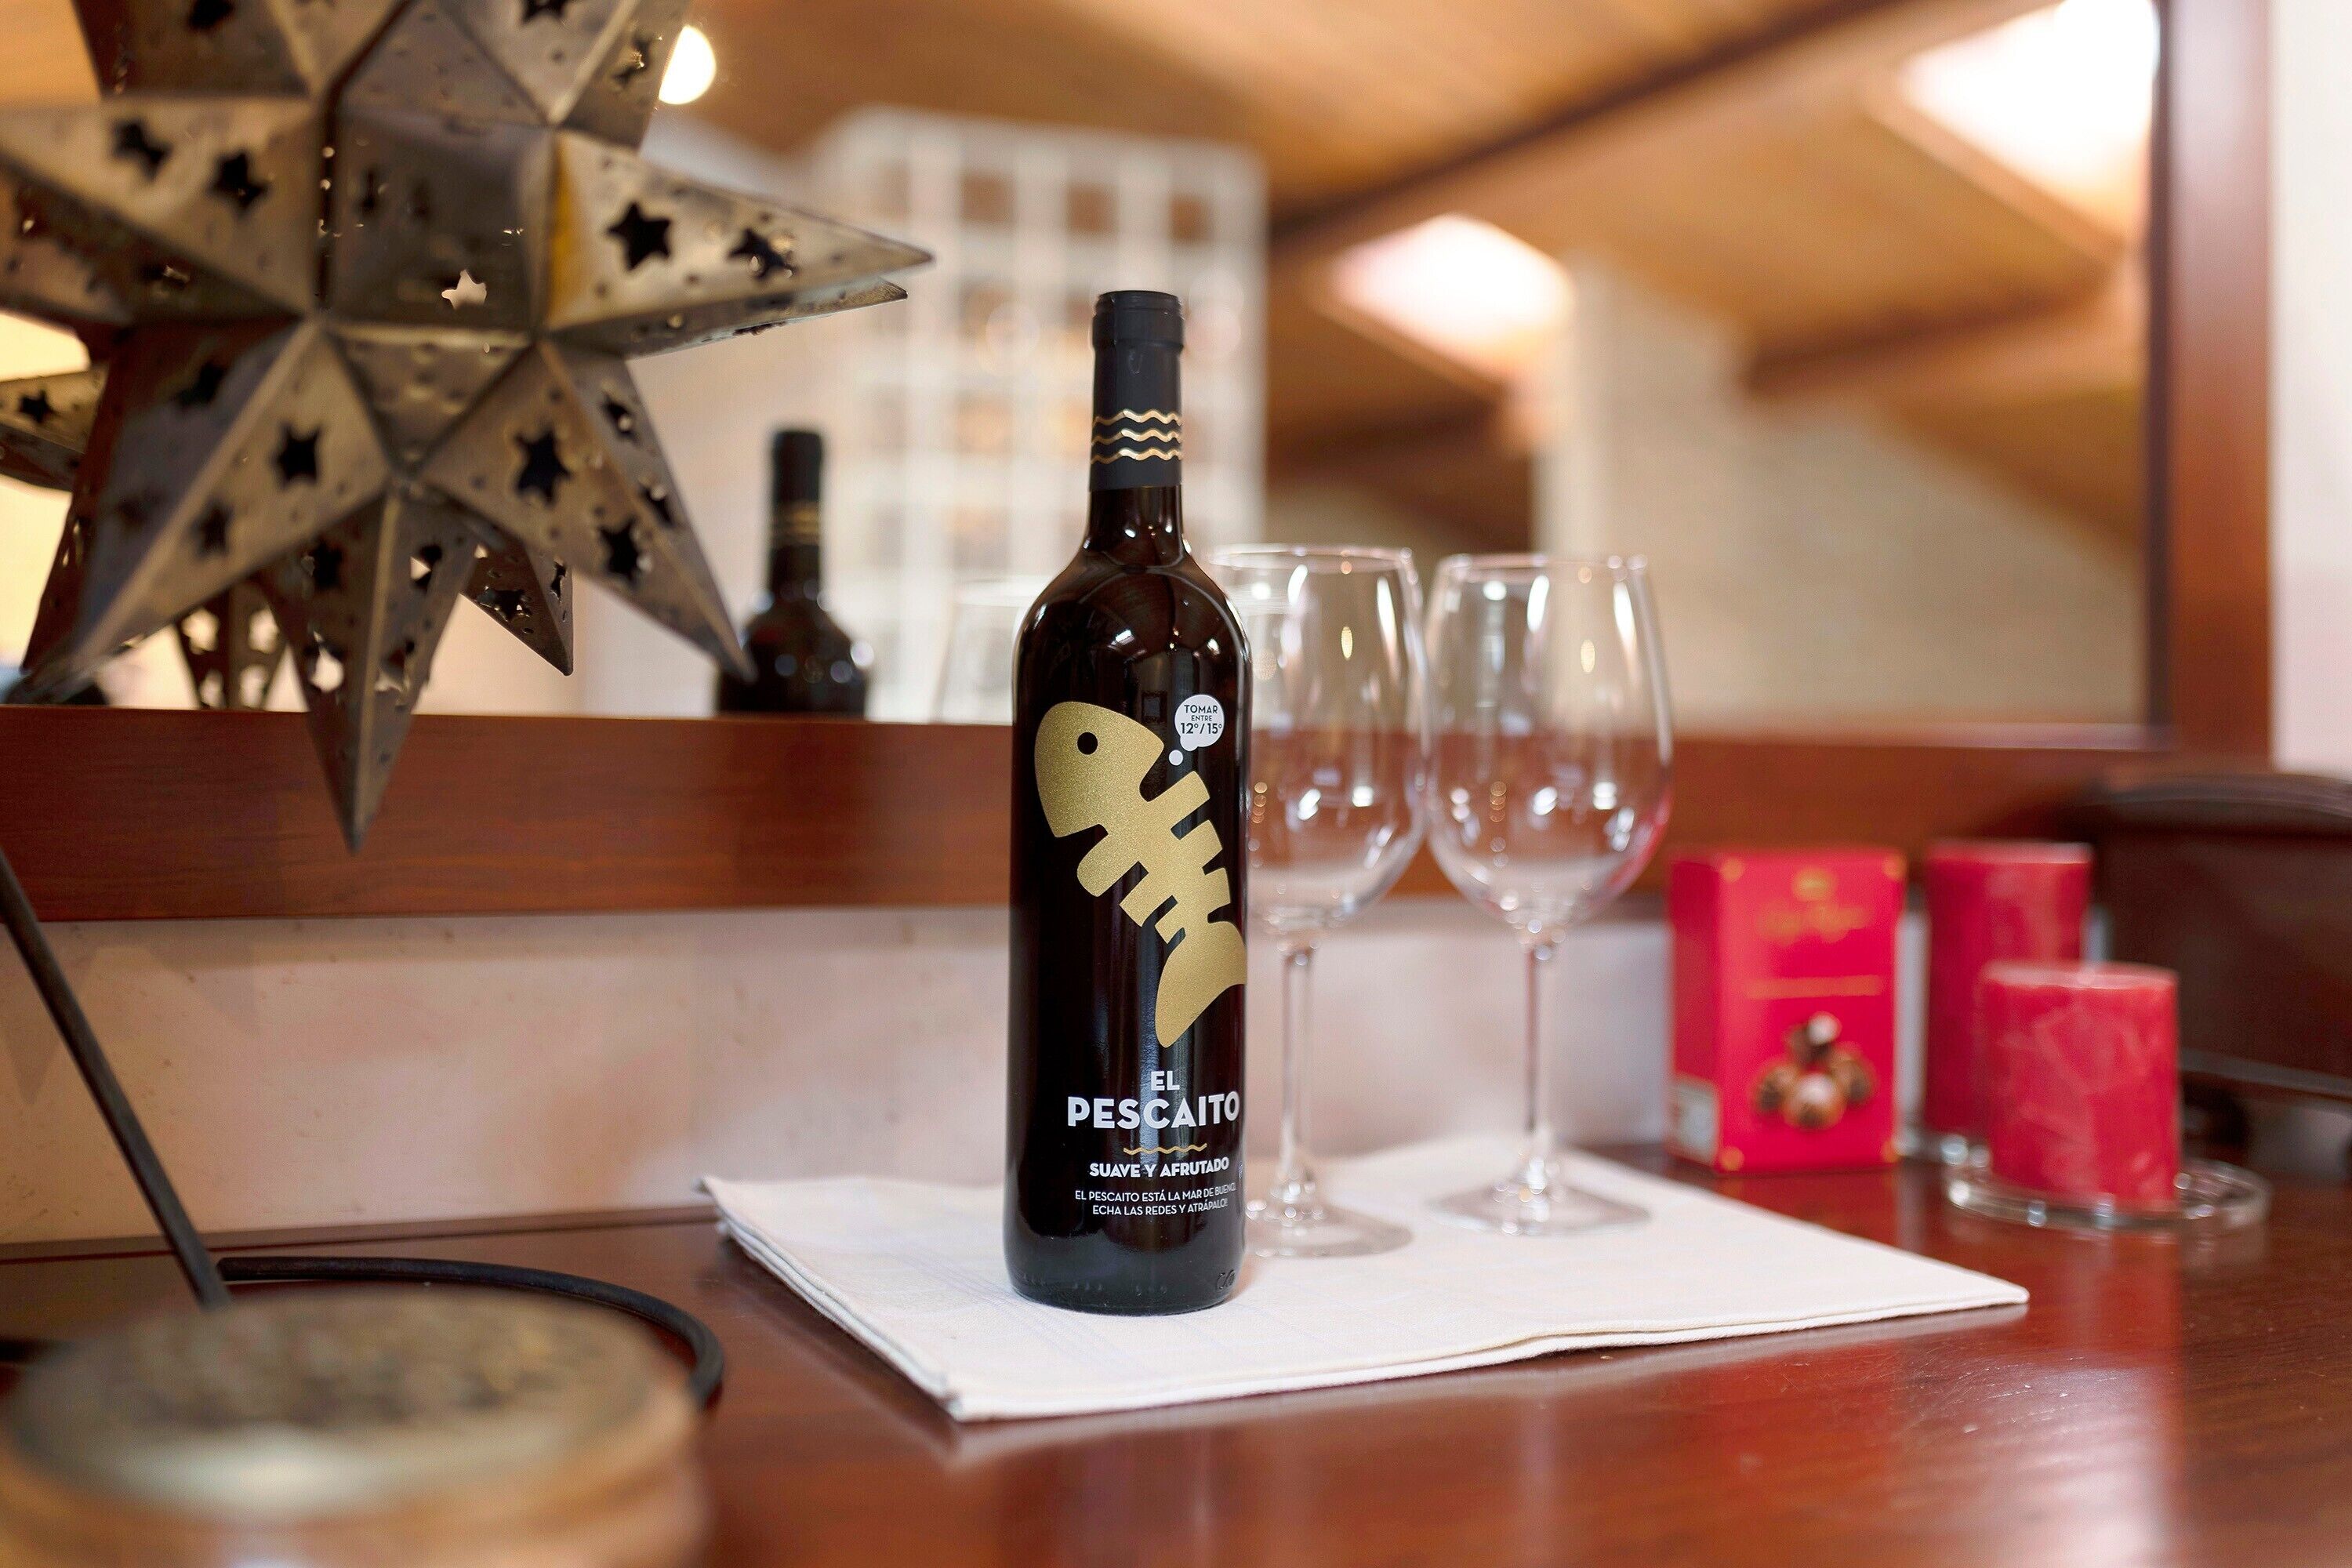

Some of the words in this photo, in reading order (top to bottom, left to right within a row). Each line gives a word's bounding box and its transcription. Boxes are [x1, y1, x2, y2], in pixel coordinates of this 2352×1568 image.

[1184, 704, 1218, 713] TOMAR
[1150, 1070, 1181, 1091] EL
[1067, 1091, 1240, 1130] PESCAITO
[1089, 1163, 1141, 1178] SUAVE
[1144, 1163, 1157, 1178] Y
[1159, 1156, 1230, 1178] AFRUTADO
[1075, 1190, 1087, 1200] EL
[1089, 1191, 1140, 1202] PESCAITO
[1142, 1189, 1166, 1202] ESTÁ
[1168, 1192, 1181, 1201] LA
[1182, 1189, 1203, 1200] MAR
[1203, 1187, 1214, 1198] DE
[1092, 1205, 1122, 1215] ECHA
[1123, 1206, 1143, 1216] LAS
[1145, 1204, 1178, 1216] REDES
[1178, 1204, 1186, 1214] Y
